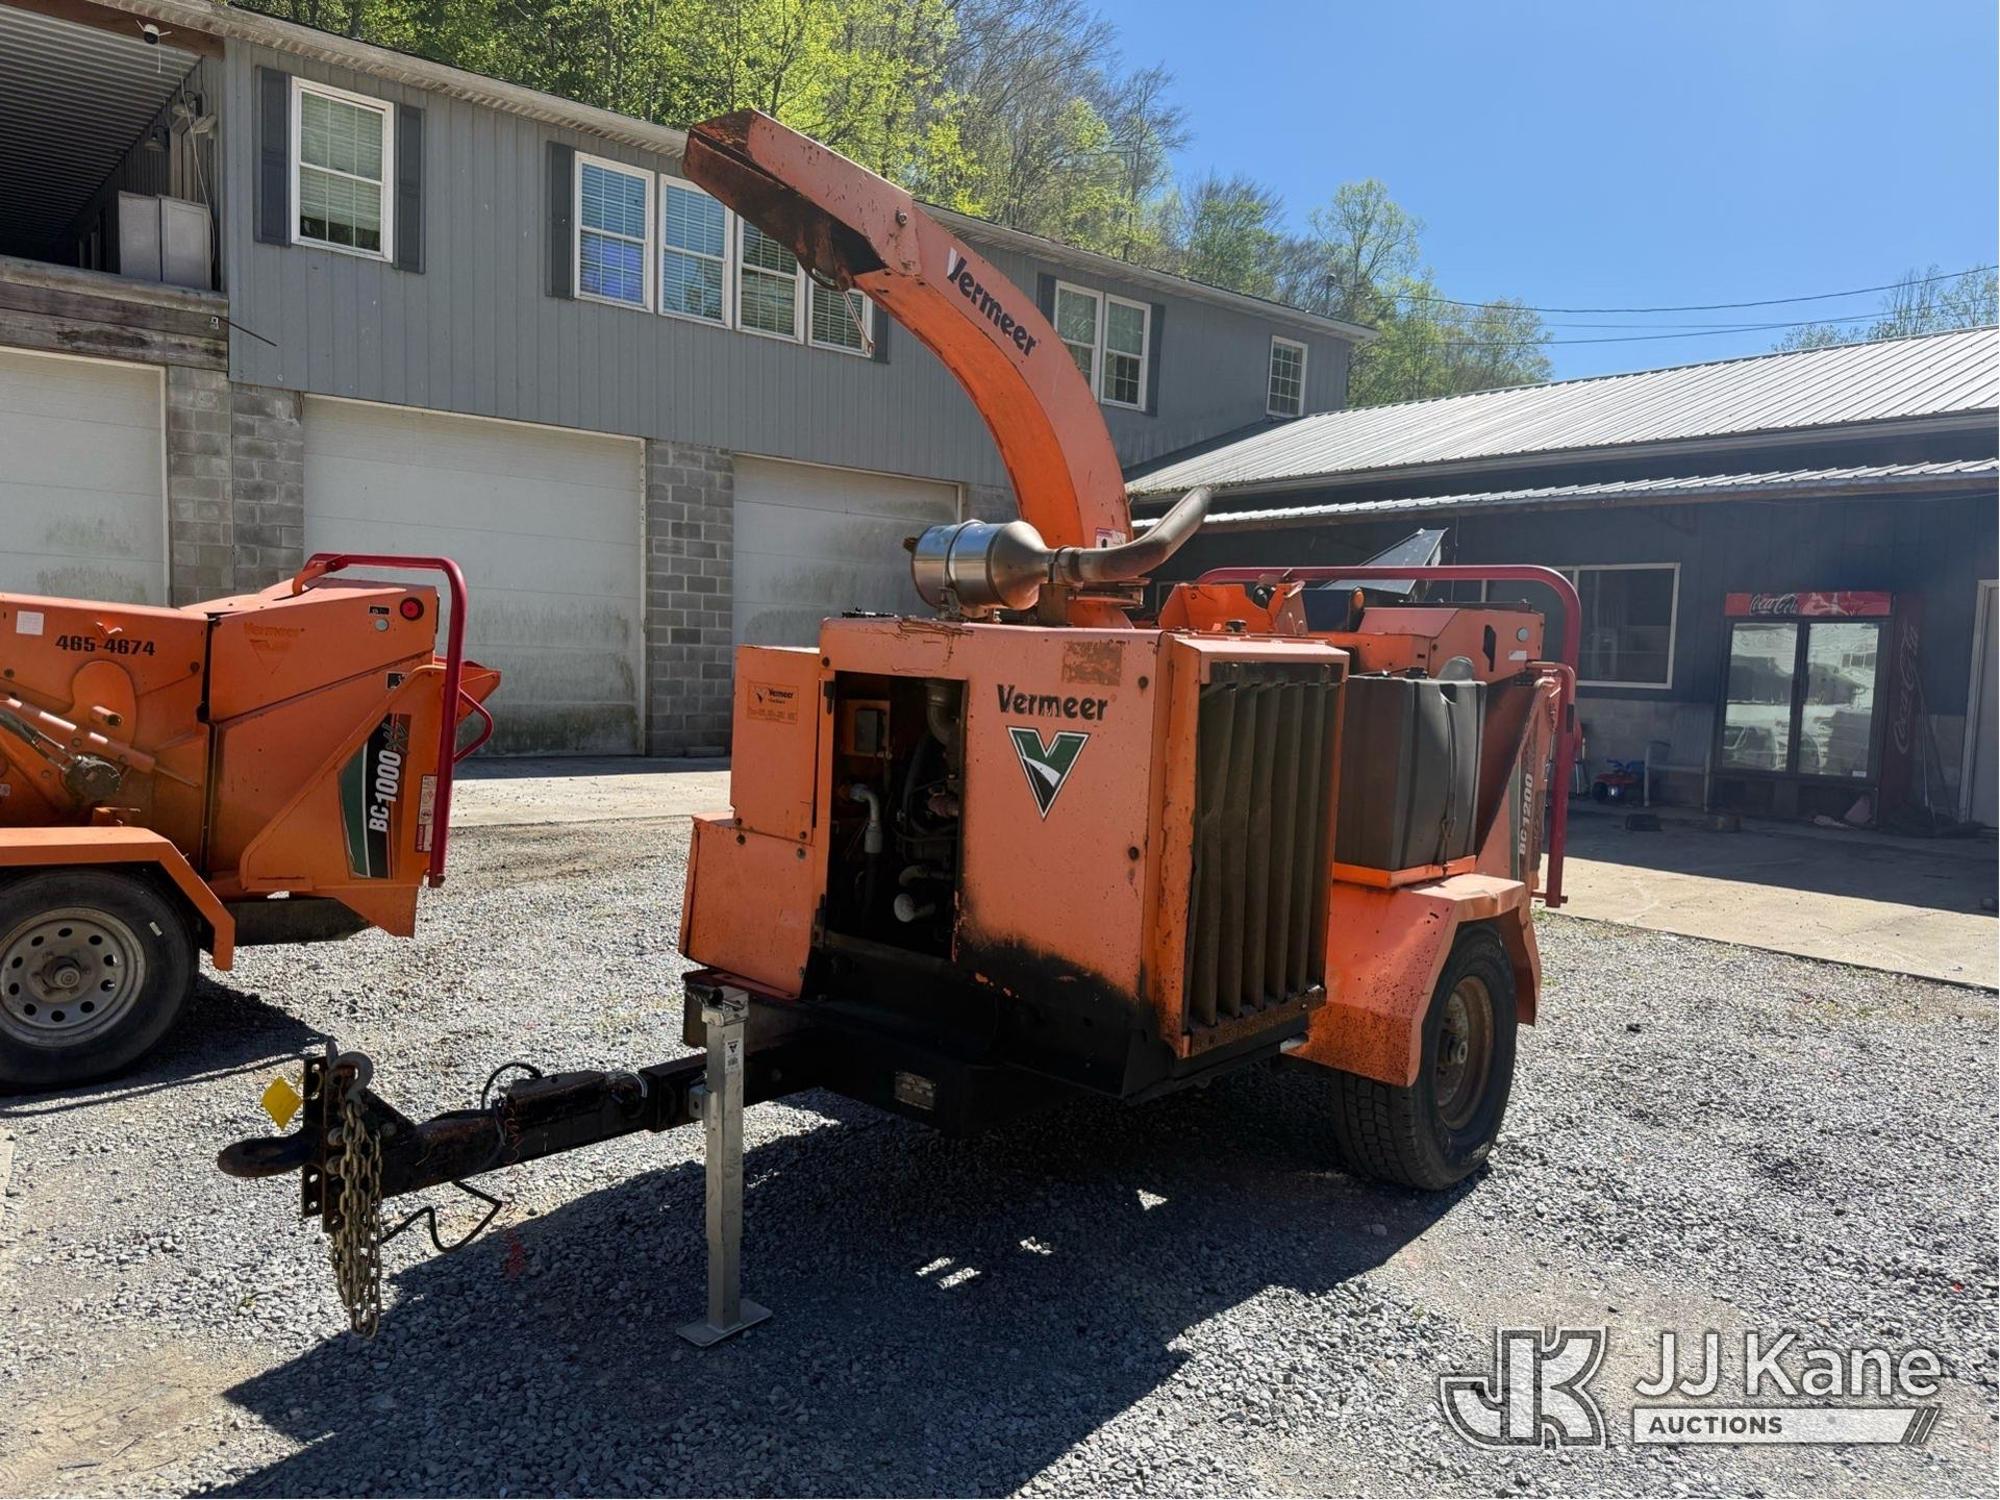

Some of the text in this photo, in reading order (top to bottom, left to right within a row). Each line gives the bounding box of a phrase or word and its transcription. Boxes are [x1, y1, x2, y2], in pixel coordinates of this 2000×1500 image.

[947, 247, 1037, 357] Vermeer
[56, 634, 156, 656] 465-4674
[996, 684, 1109, 721] Vermeer
